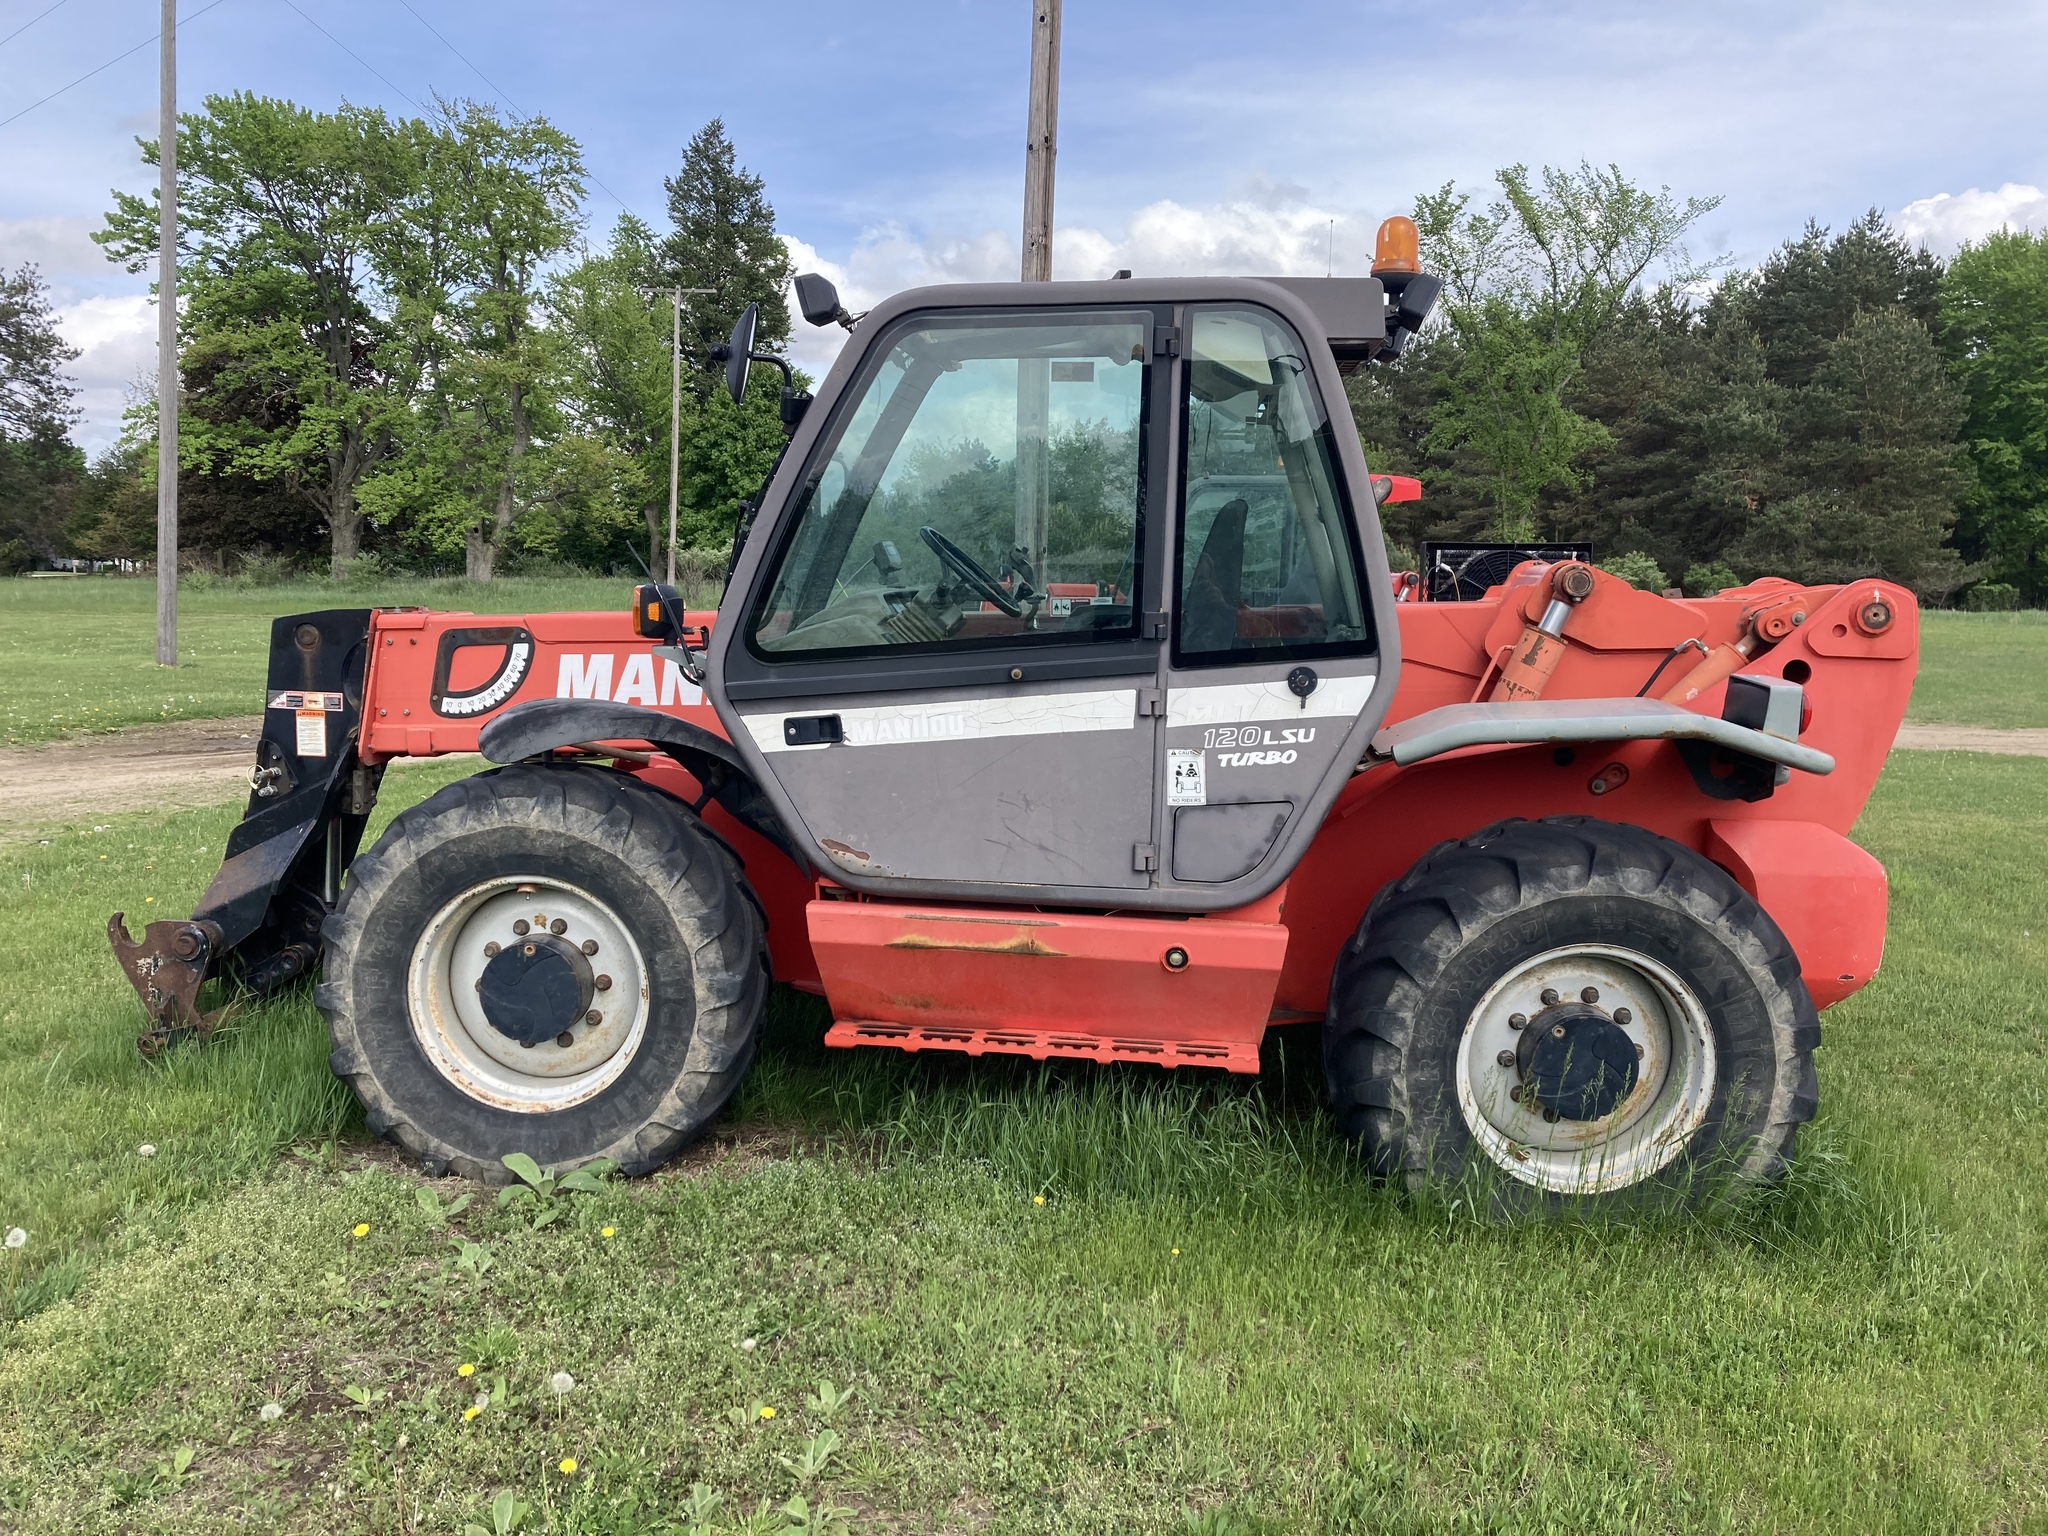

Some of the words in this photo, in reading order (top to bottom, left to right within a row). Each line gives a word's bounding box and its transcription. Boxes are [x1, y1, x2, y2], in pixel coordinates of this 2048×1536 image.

[556, 653, 713, 706] MAN
[851, 707, 964, 742] MANITOU
[1218, 749, 1298, 767] TURBO
